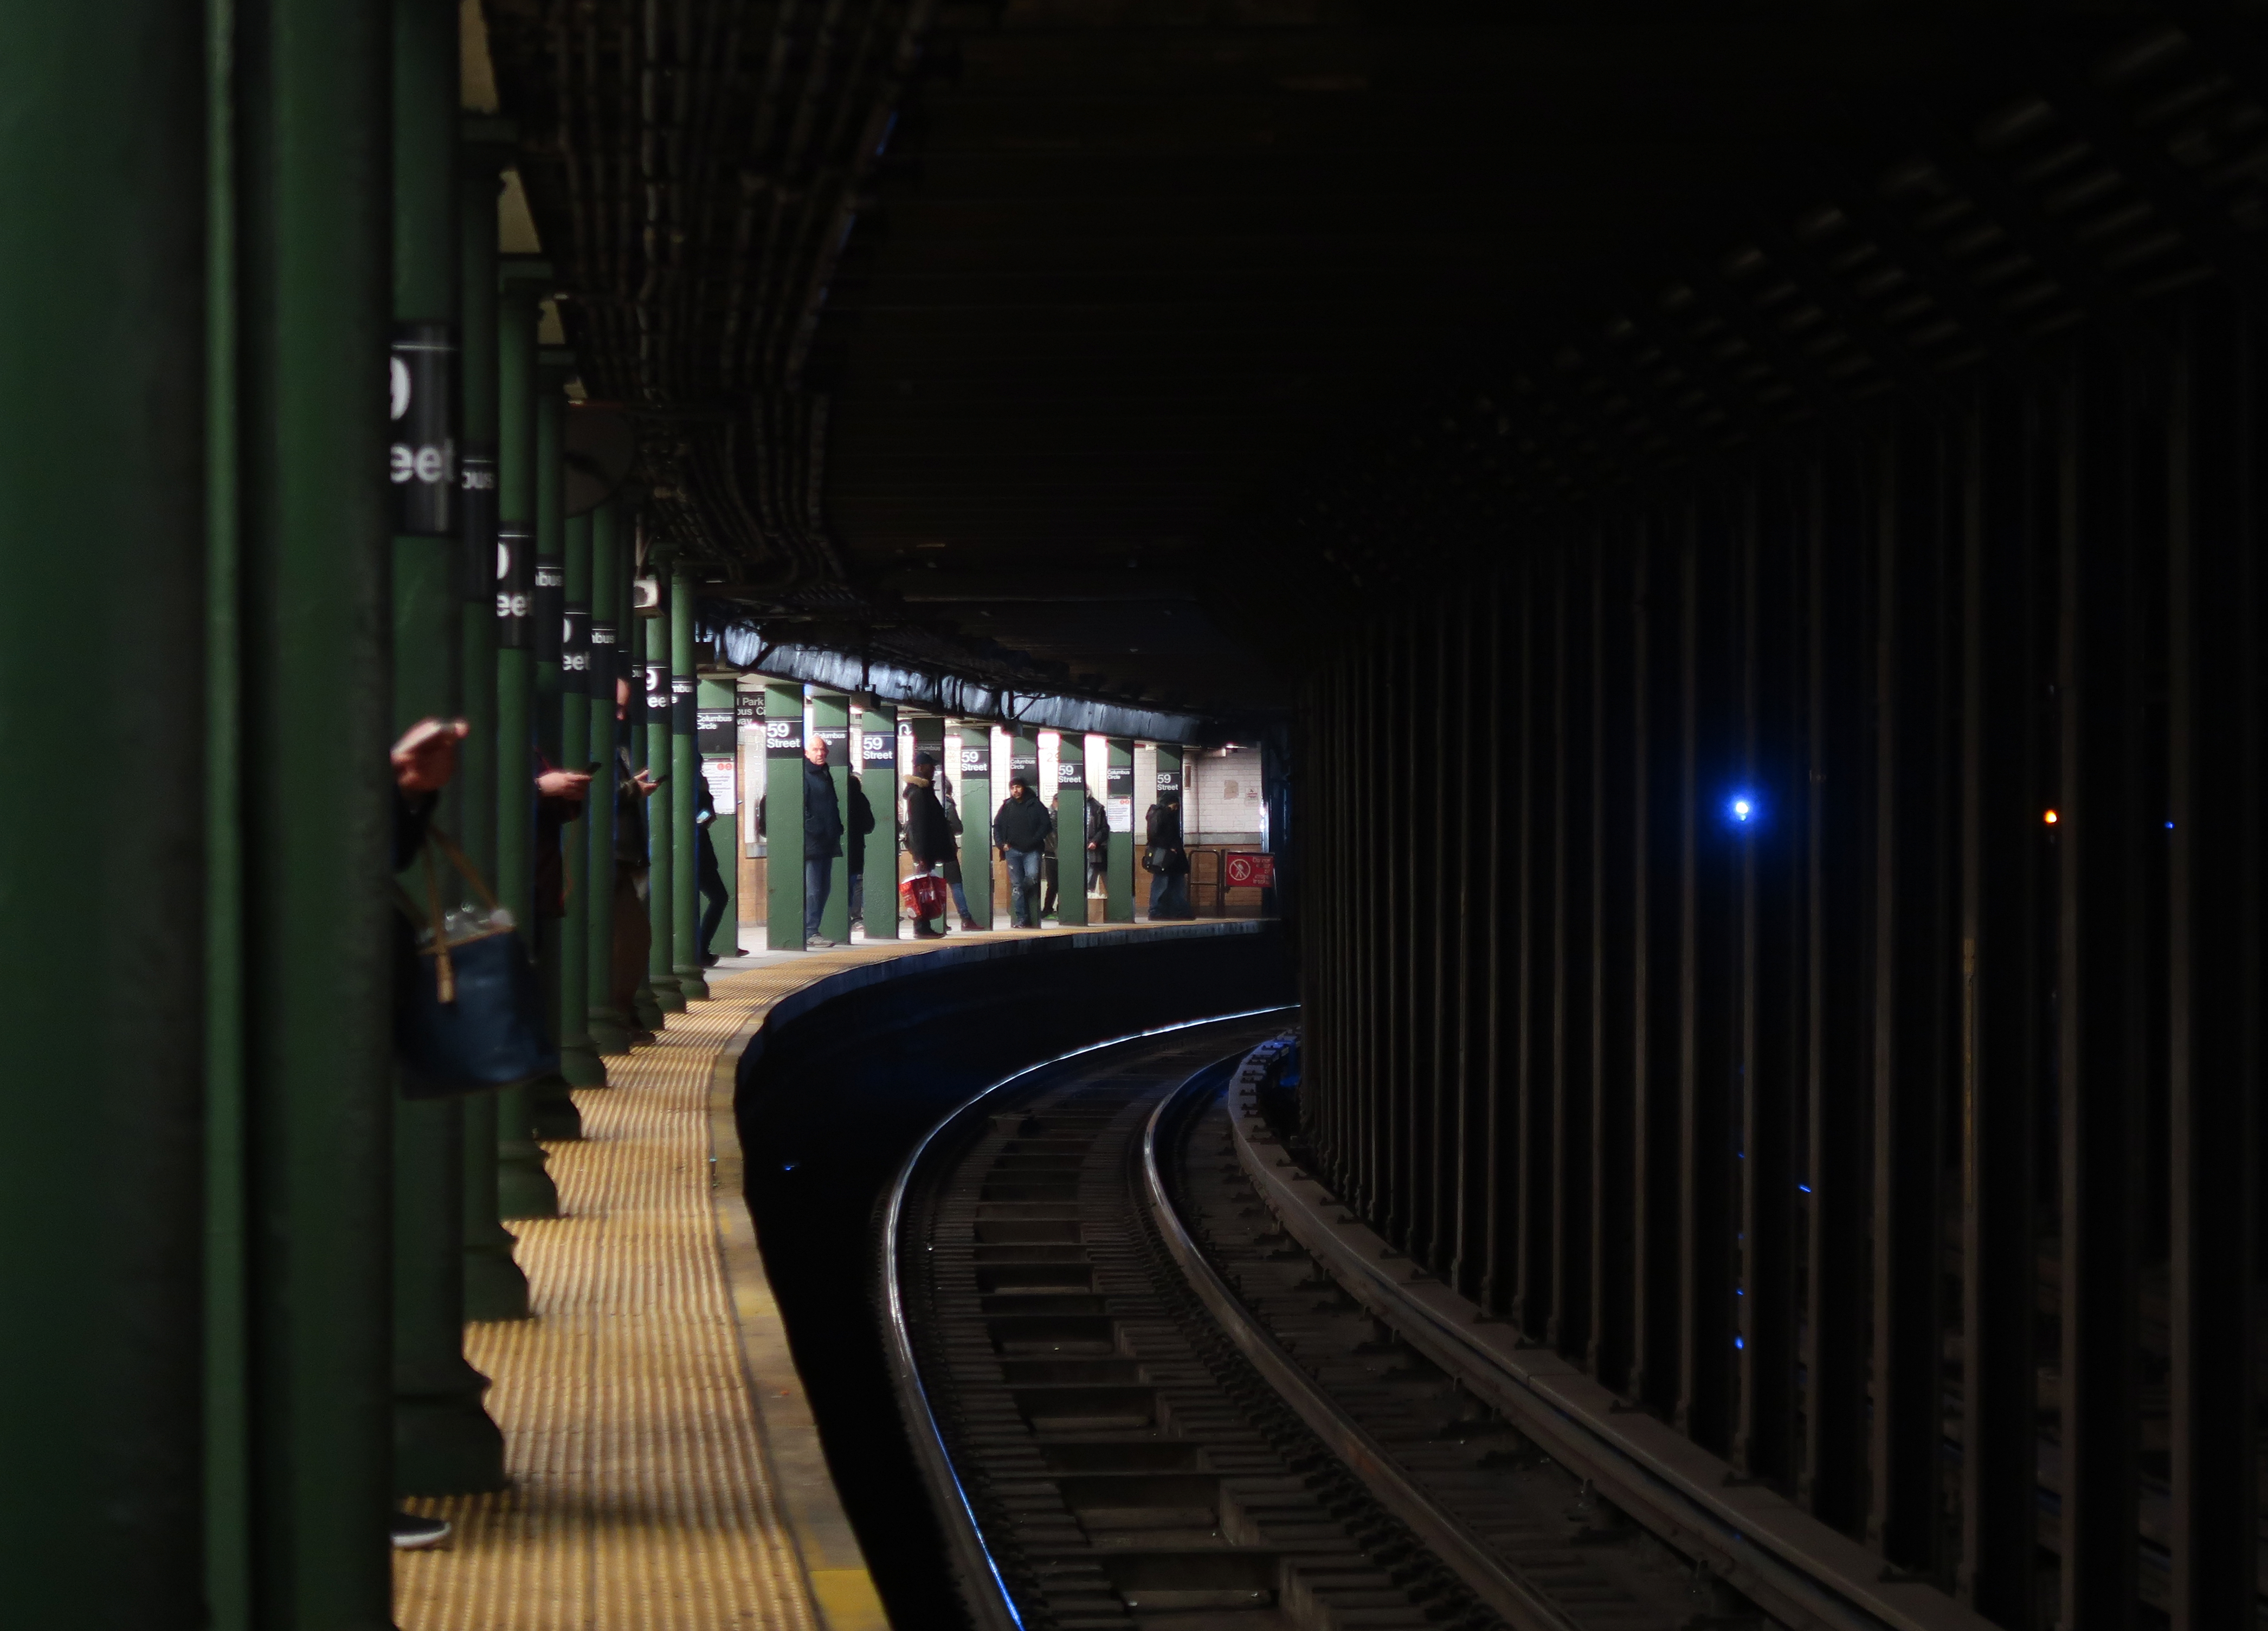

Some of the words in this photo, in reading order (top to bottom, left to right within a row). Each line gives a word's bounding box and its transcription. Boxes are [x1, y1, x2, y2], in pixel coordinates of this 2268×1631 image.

[743, 697, 764, 706] Park
[697, 714, 732, 723] Columbus
[697, 722, 718, 730] Circle
[767, 723, 790, 738] 59
[766, 738, 801, 749] Street
[863, 737, 884, 750] 59
[863, 750, 893, 760] Street
[961, 751, 979, 763] 59
[961, 763, 988, 772] Street
[1058, 765, 1074, 776] 59
[1058, 776, 1082, 784] Street
[1157, 773, 1171, 784] 59
